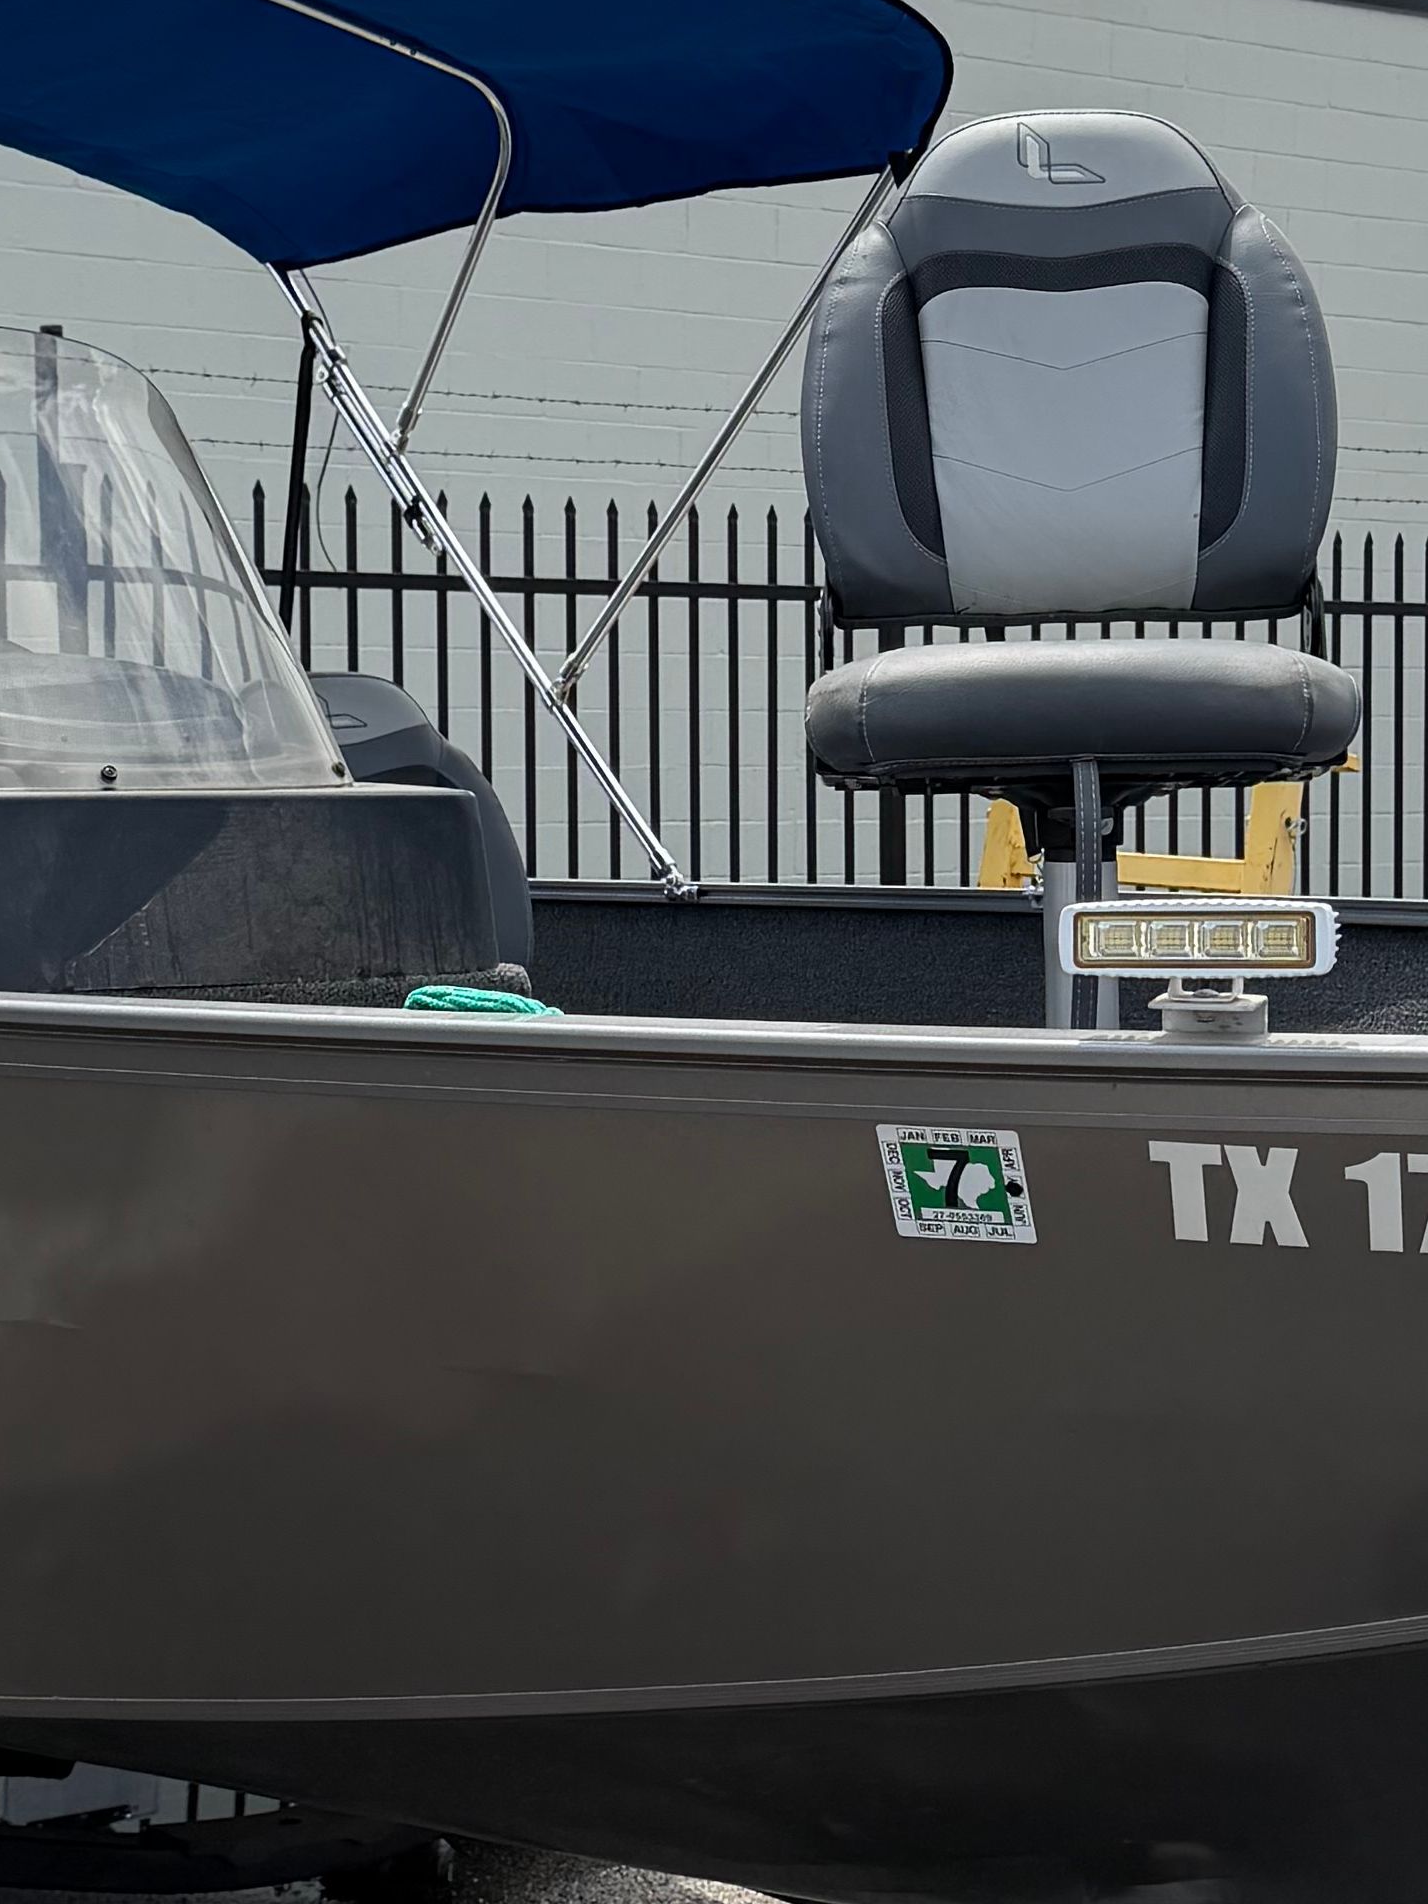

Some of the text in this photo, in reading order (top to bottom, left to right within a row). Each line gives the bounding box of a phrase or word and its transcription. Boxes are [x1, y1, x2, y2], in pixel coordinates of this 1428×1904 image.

[899, 1130, 997, 1145] JAN FEB MAR
[927, 1148, 970, 1208] 7
[1149, 1140, 1310, 1248] TX
[918, 1222, 945, 1233] SEP
[952, 1225, 979, 1236] AUG
